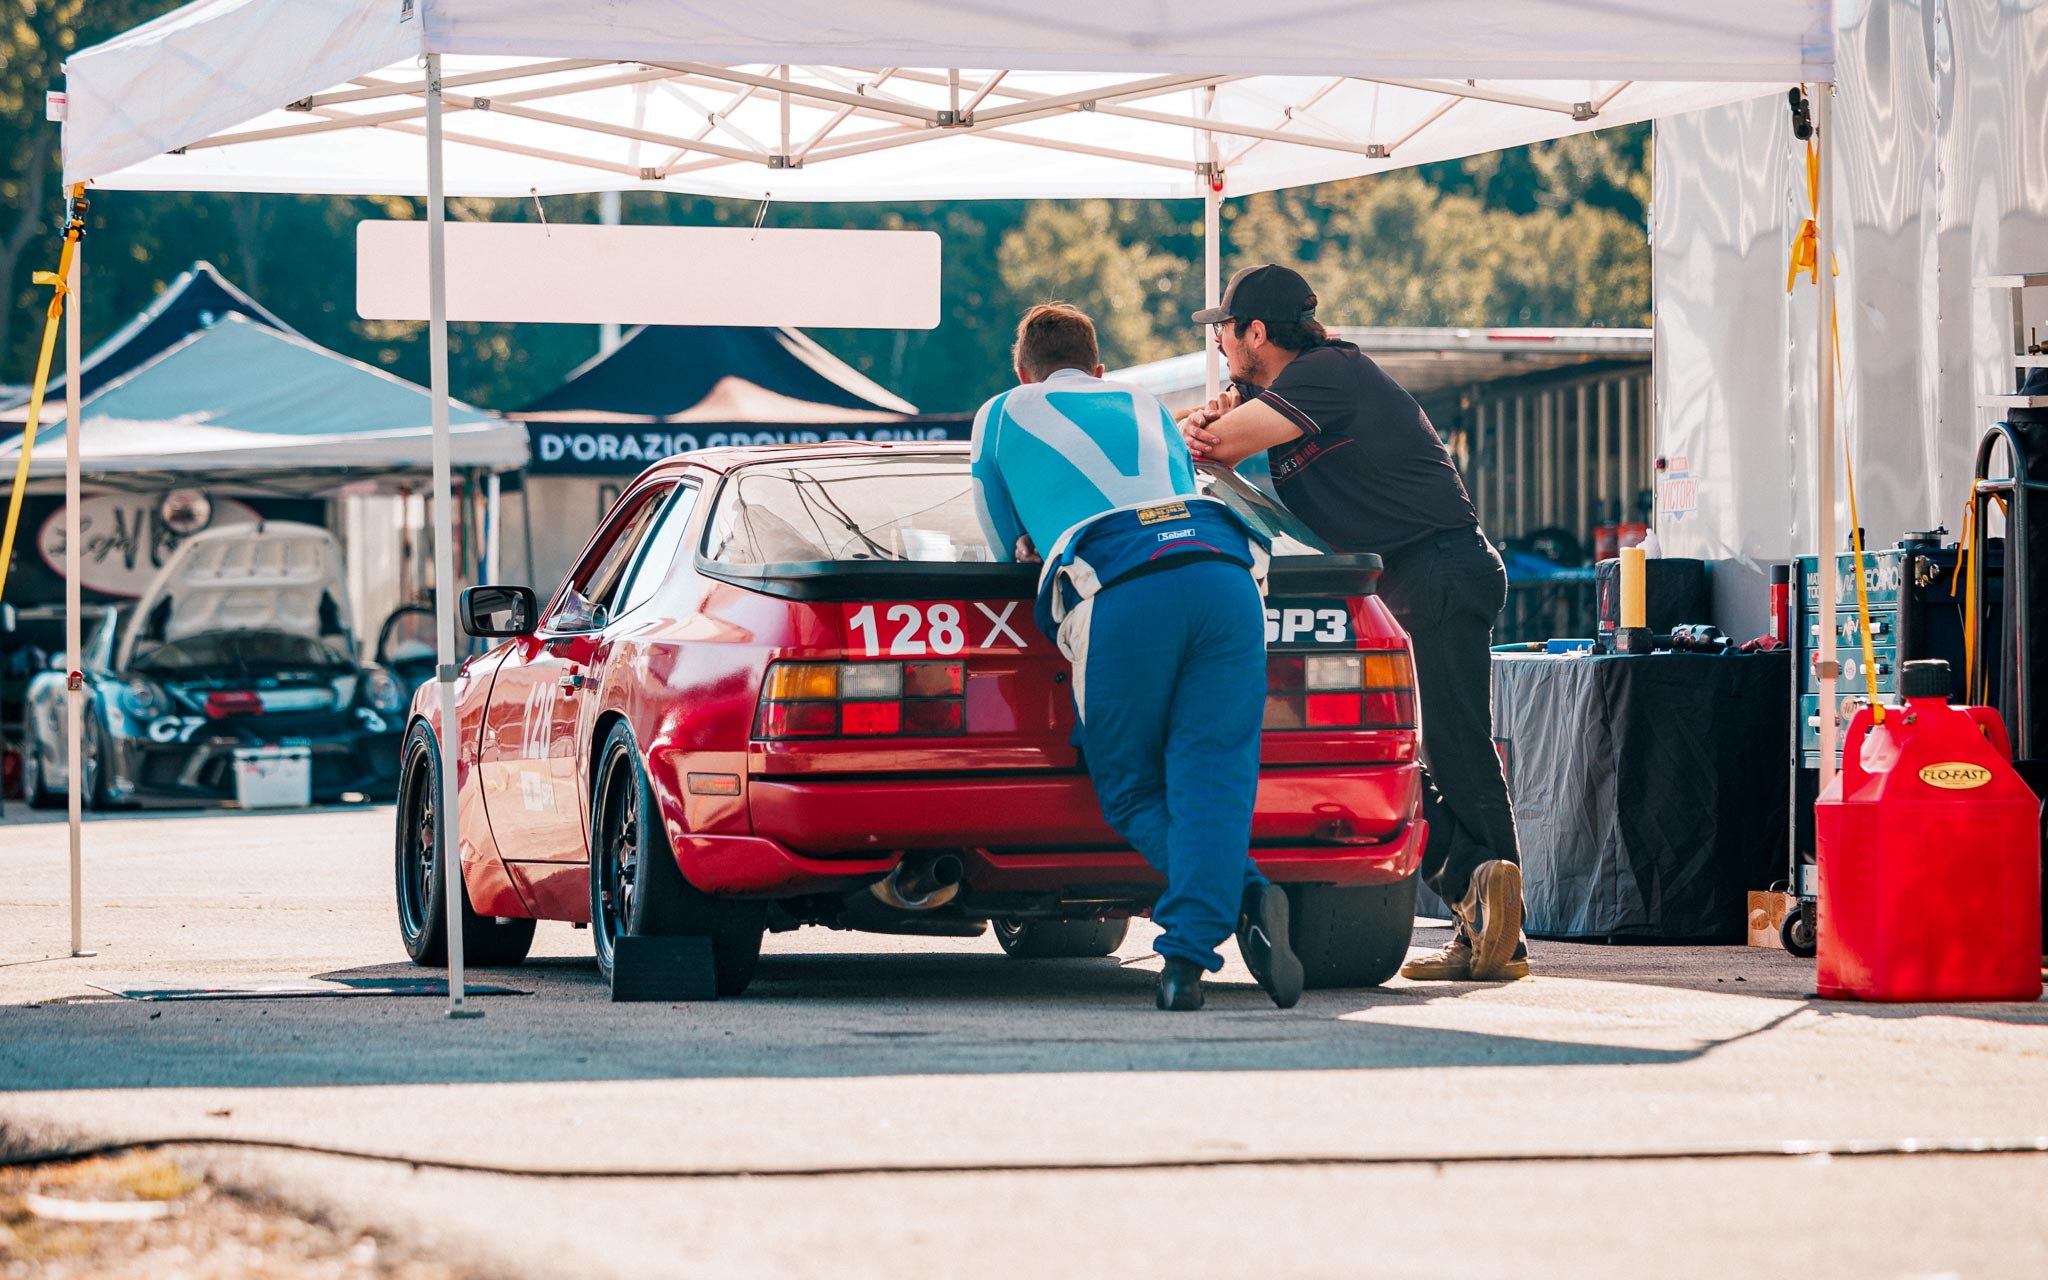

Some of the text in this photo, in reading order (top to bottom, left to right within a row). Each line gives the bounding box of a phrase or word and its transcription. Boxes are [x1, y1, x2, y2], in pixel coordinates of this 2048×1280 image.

[539, 432, 699, 462] D'ORAZIO
[1661, 479, 1697, 511] VICTORY
[1865, 566, 1899, 591] ECARO
[850, 601, 1028, 657] 128 X
[149, 715, 206, 743] C7
[522, 681, 556, 759] 128
